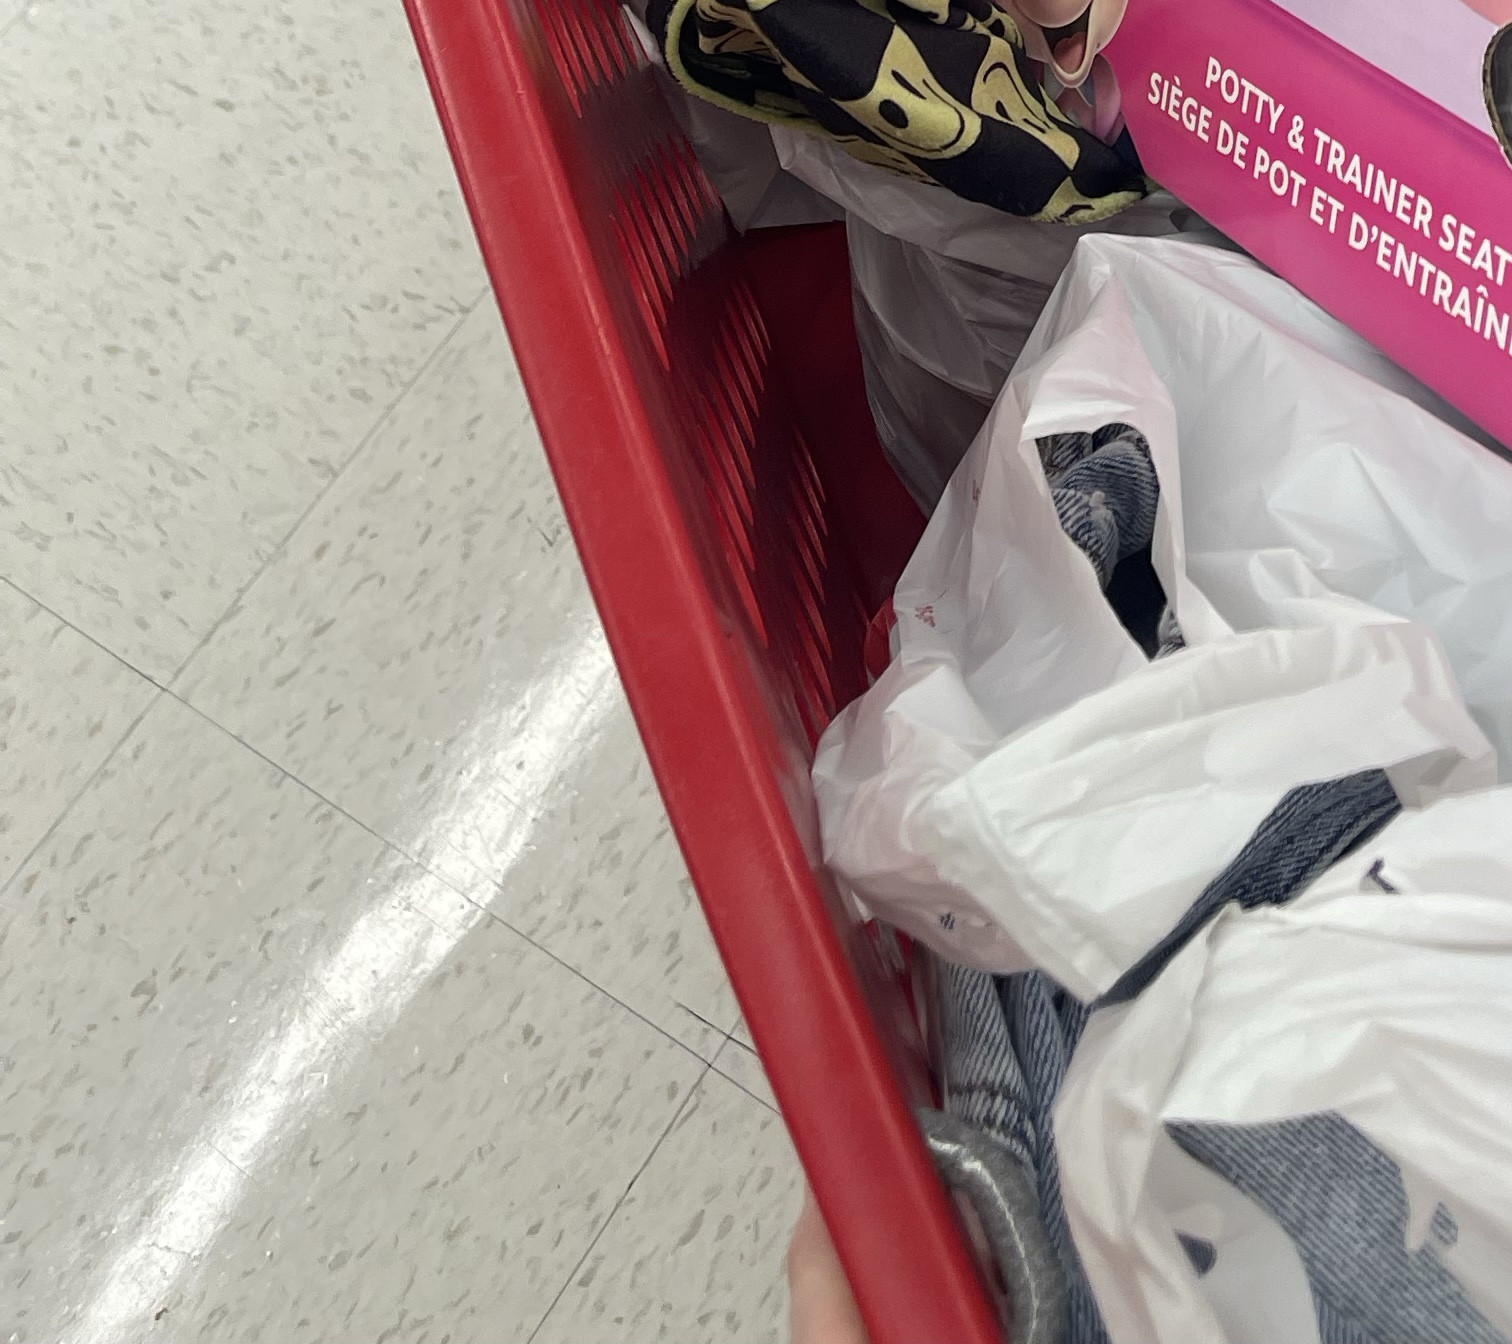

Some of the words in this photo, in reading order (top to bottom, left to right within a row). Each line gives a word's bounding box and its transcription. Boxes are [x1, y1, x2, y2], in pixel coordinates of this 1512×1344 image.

[1147, 71, 1211, 143] SIÈGE
[1216, 120, 1248, 170] DE
[1253, 152, 1306, 207] POT
[1310, 187, 1345, 234] ET
[1205, 56, 1285, 133] POTTY
[1287, 114, 1304, 155] &
[1313, 129, 1433, 239] TRAINER
